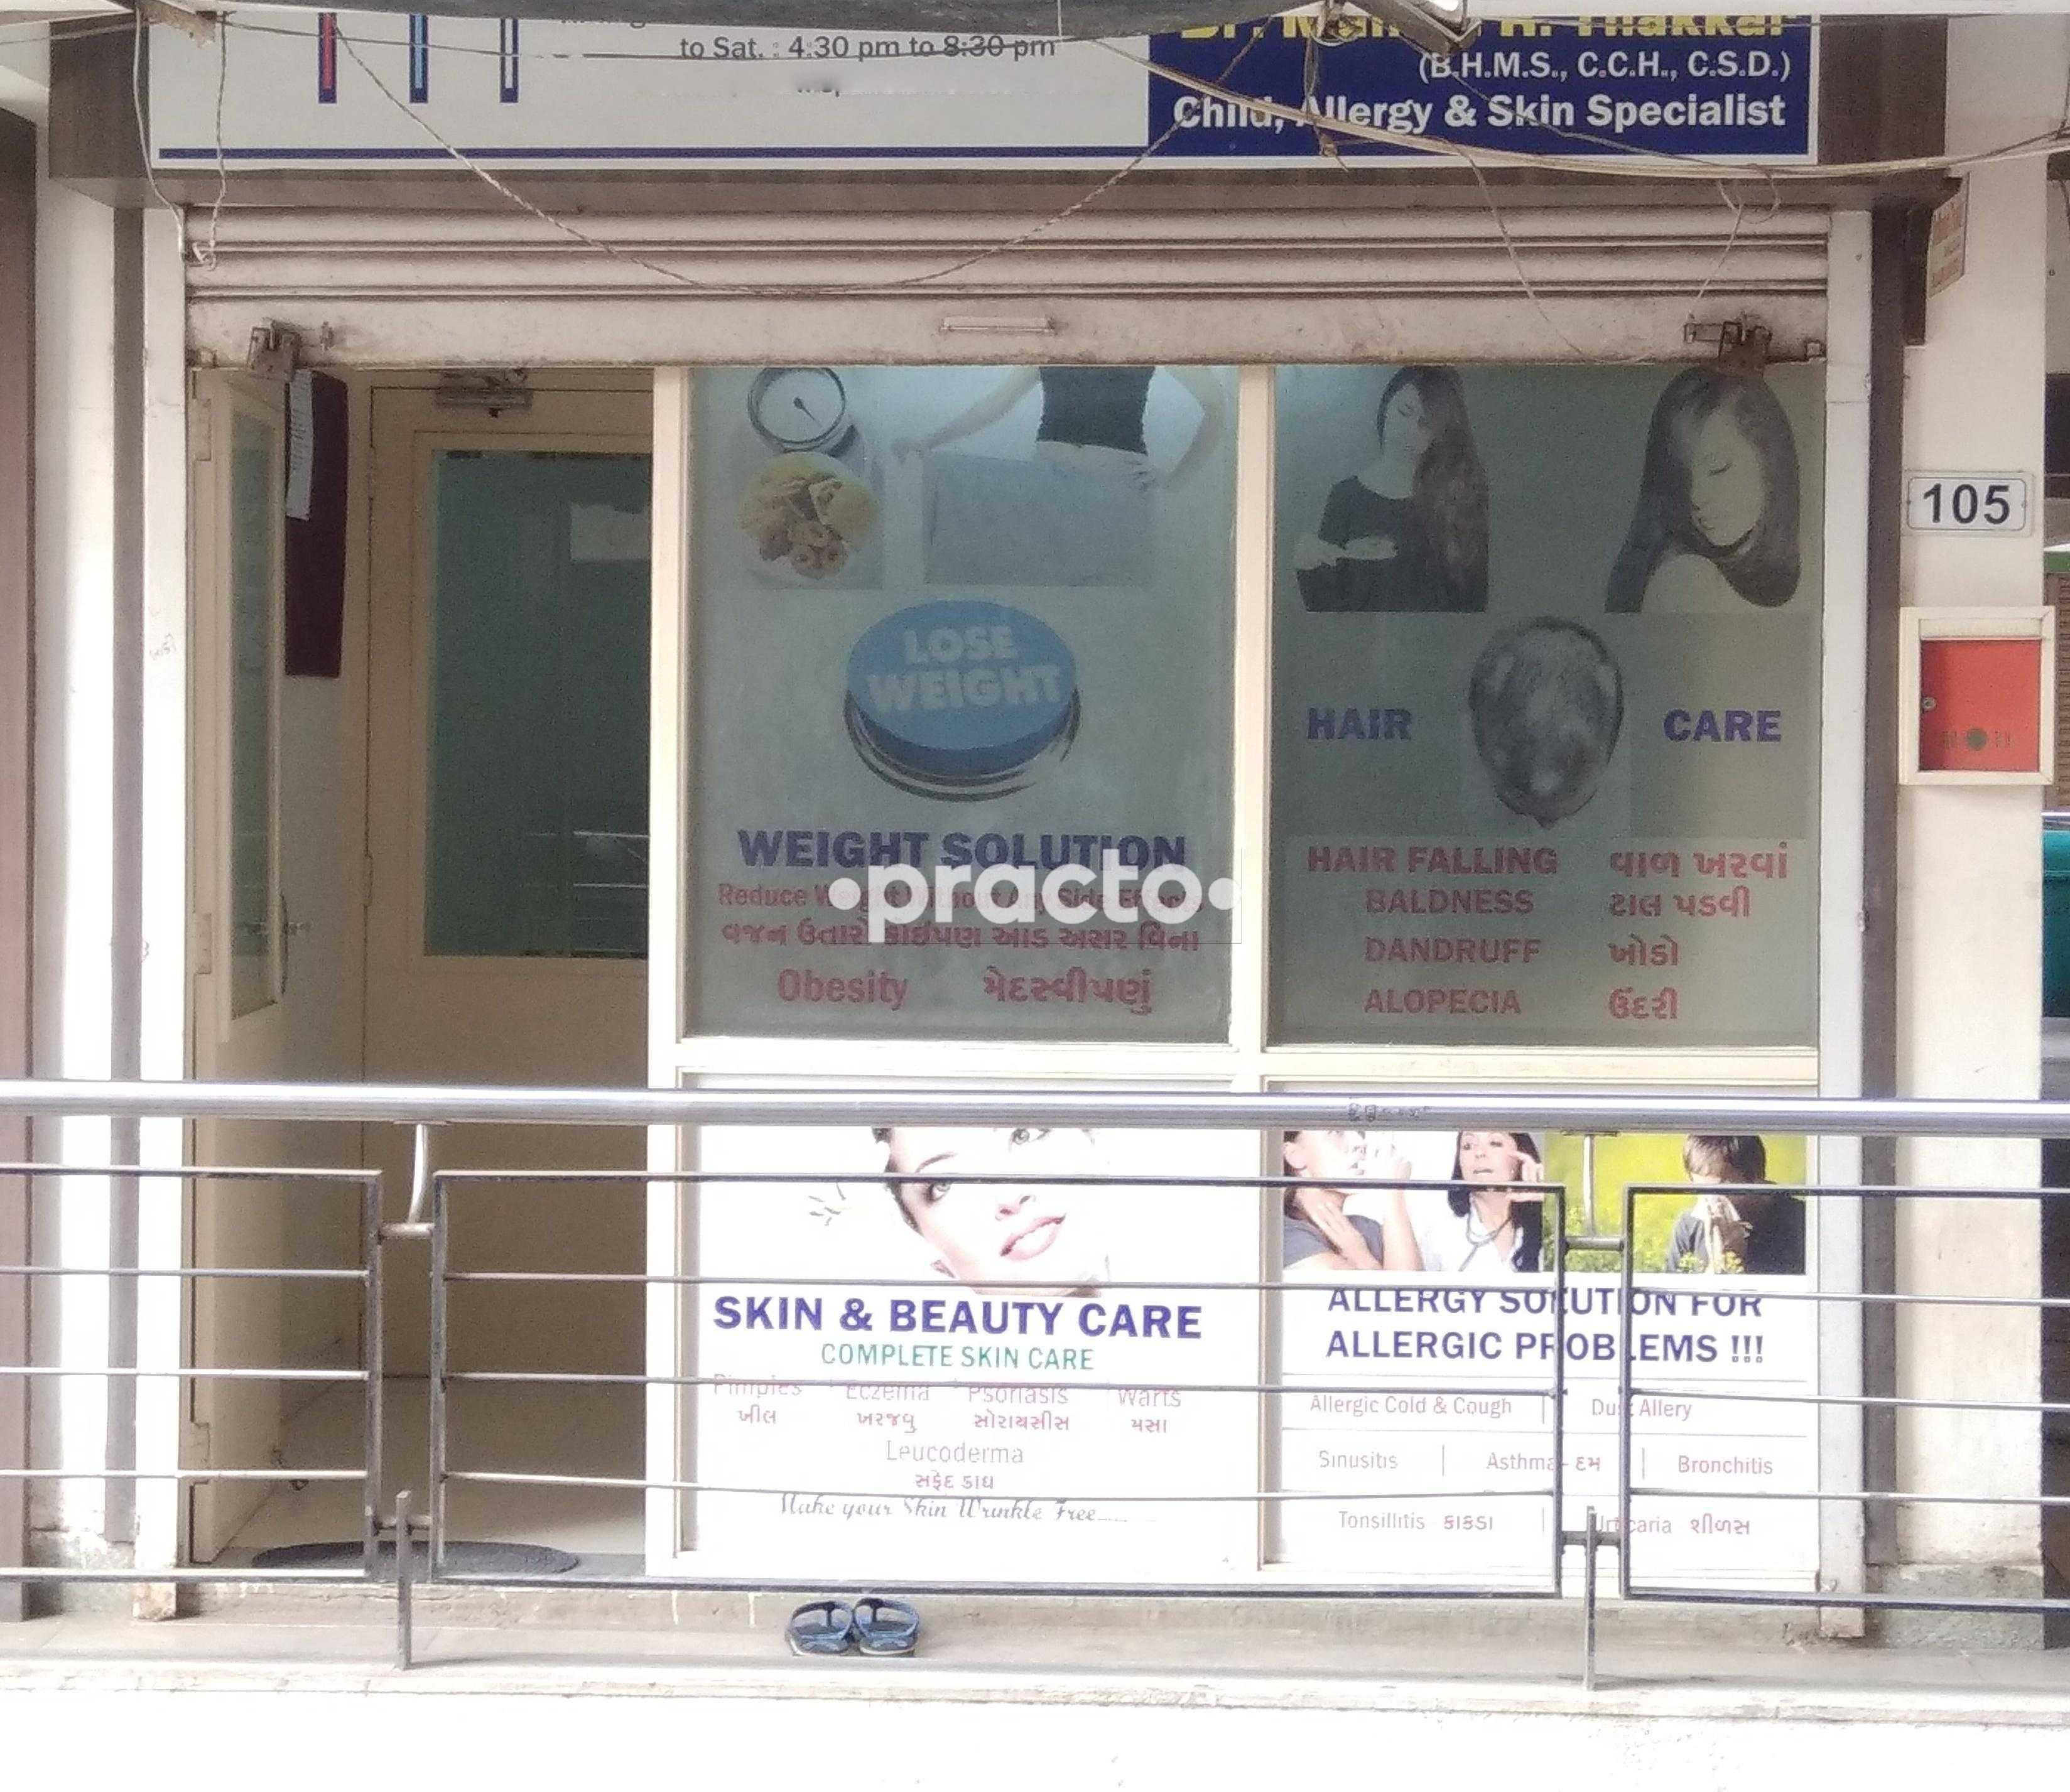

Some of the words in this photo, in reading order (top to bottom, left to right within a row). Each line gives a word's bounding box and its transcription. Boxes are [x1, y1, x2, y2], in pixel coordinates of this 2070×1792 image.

[680, 37, 705, 58] to
[713, 36, 764, 58] Sat.
[788, 35, 849, 58] 4:30
[859, 38, 900, 62] pm
[909, 36, 934, 57] to
[943, 35, 1005, 57] 8:30
[1014, 38, 1056, 61] pm
[1577, 51, 1678, 82] C.C.H.,
[1688, 51, 1791, 83] C.S.D.)
[1444, 94, 1477, 127] &
[1488, 94, 1574, 127] Skin
[1586, 94, 1786, 134] Specialist
[1923, 482, 2011, 525] 105
[902, 625, 1020, 664] LOSE
[867, 664, 1061, 711] WEIGHT
[1307, 707, 1414, 740] HAIR
[1663, 709, 1782, 742] CARE
[737, 829, 929, 869] WEIGHT
[941, 831, 1186, 872] SOLUTION
[1307, 846, 1397, 873] HAIR
[1407, 846, 1558, 875] FALLING
[1609, 852, 1681, 878] વાળ
[718, 883, 806, 907] Reduce
[1364, 888, 1534, 914] BALDNESS
[1609, 893, 1662, 917] ટાલ
[1673, 885, 1750, 917] પડવી
[1364, 936, 1541, 963] DANDRUFF
[1608, 934, 1679, 966] ખોડો
[778, 968, 909, 1011] Obesity
[1363, 988, 1522, 1015] ALOPECIA
[1327, 1288, 1489, 1314] ALLERGY
[1691, 1293, 1762, 1317] FOR
[713, 1295, 823, 1331] SKIN
[839, 1297, 873, 1332] &
[889, 1299, 1065, 1336] BEAUTY
[1078, 1302, 1202, 1339] CARE
[821, 1342, 953, 1368] COMPLETE
[960, 1345, 1019, 1369] SKIN
[1028, 1347, 1095, 1370] CARE
[1325, 1330, 1502, 1360] ALLERGIC
[1515, 1331, 1718, 1363] PROBEMS
[1731, 1335, 1764, 1363] !!!
[713, 1373, 803, 1399] Pimples
[846, 1381, 930, 1401] Eczema
[968, 1384, 1070, 1405] Psoriasis
[1117, 1387, 1182, 1408] Warts
[737, 1403, 777, 1425] ખીલ
[1309, 1395, 1379, 1417] Allergic
[1385, 1395, 1426, 1414] Cold
[1433, 1396, 1448, 1415] &
[1453, 1396, 1512, 1419] Cough
[1591, 1398, 1634, 1417] Du
[1639, 1398, 1693, 1422] Allery
[1130, 1418, 1167, 1434] મસા
[886, 1439, 1024, 1464] Leucoderma
[1319, 1450, 1399, 1469] Sinusitis
[1486, 1452, 1556, 1471] Asthma
[1575, 1455, 1601, 1472] દમ
[1678, 1454, 1773, 1475] Bronchitis
[781, 1492, 835, 1516] Make
[842, 1500, 892, 1521] your
[903, 1496, 947, 1519] Skin
[959, 1496, 1043, 1519] Wrinkle
[1338, 1509, 1426, 1531] Tonsillitis
[1596, 1514, 1672, 1535] Urtcaria
